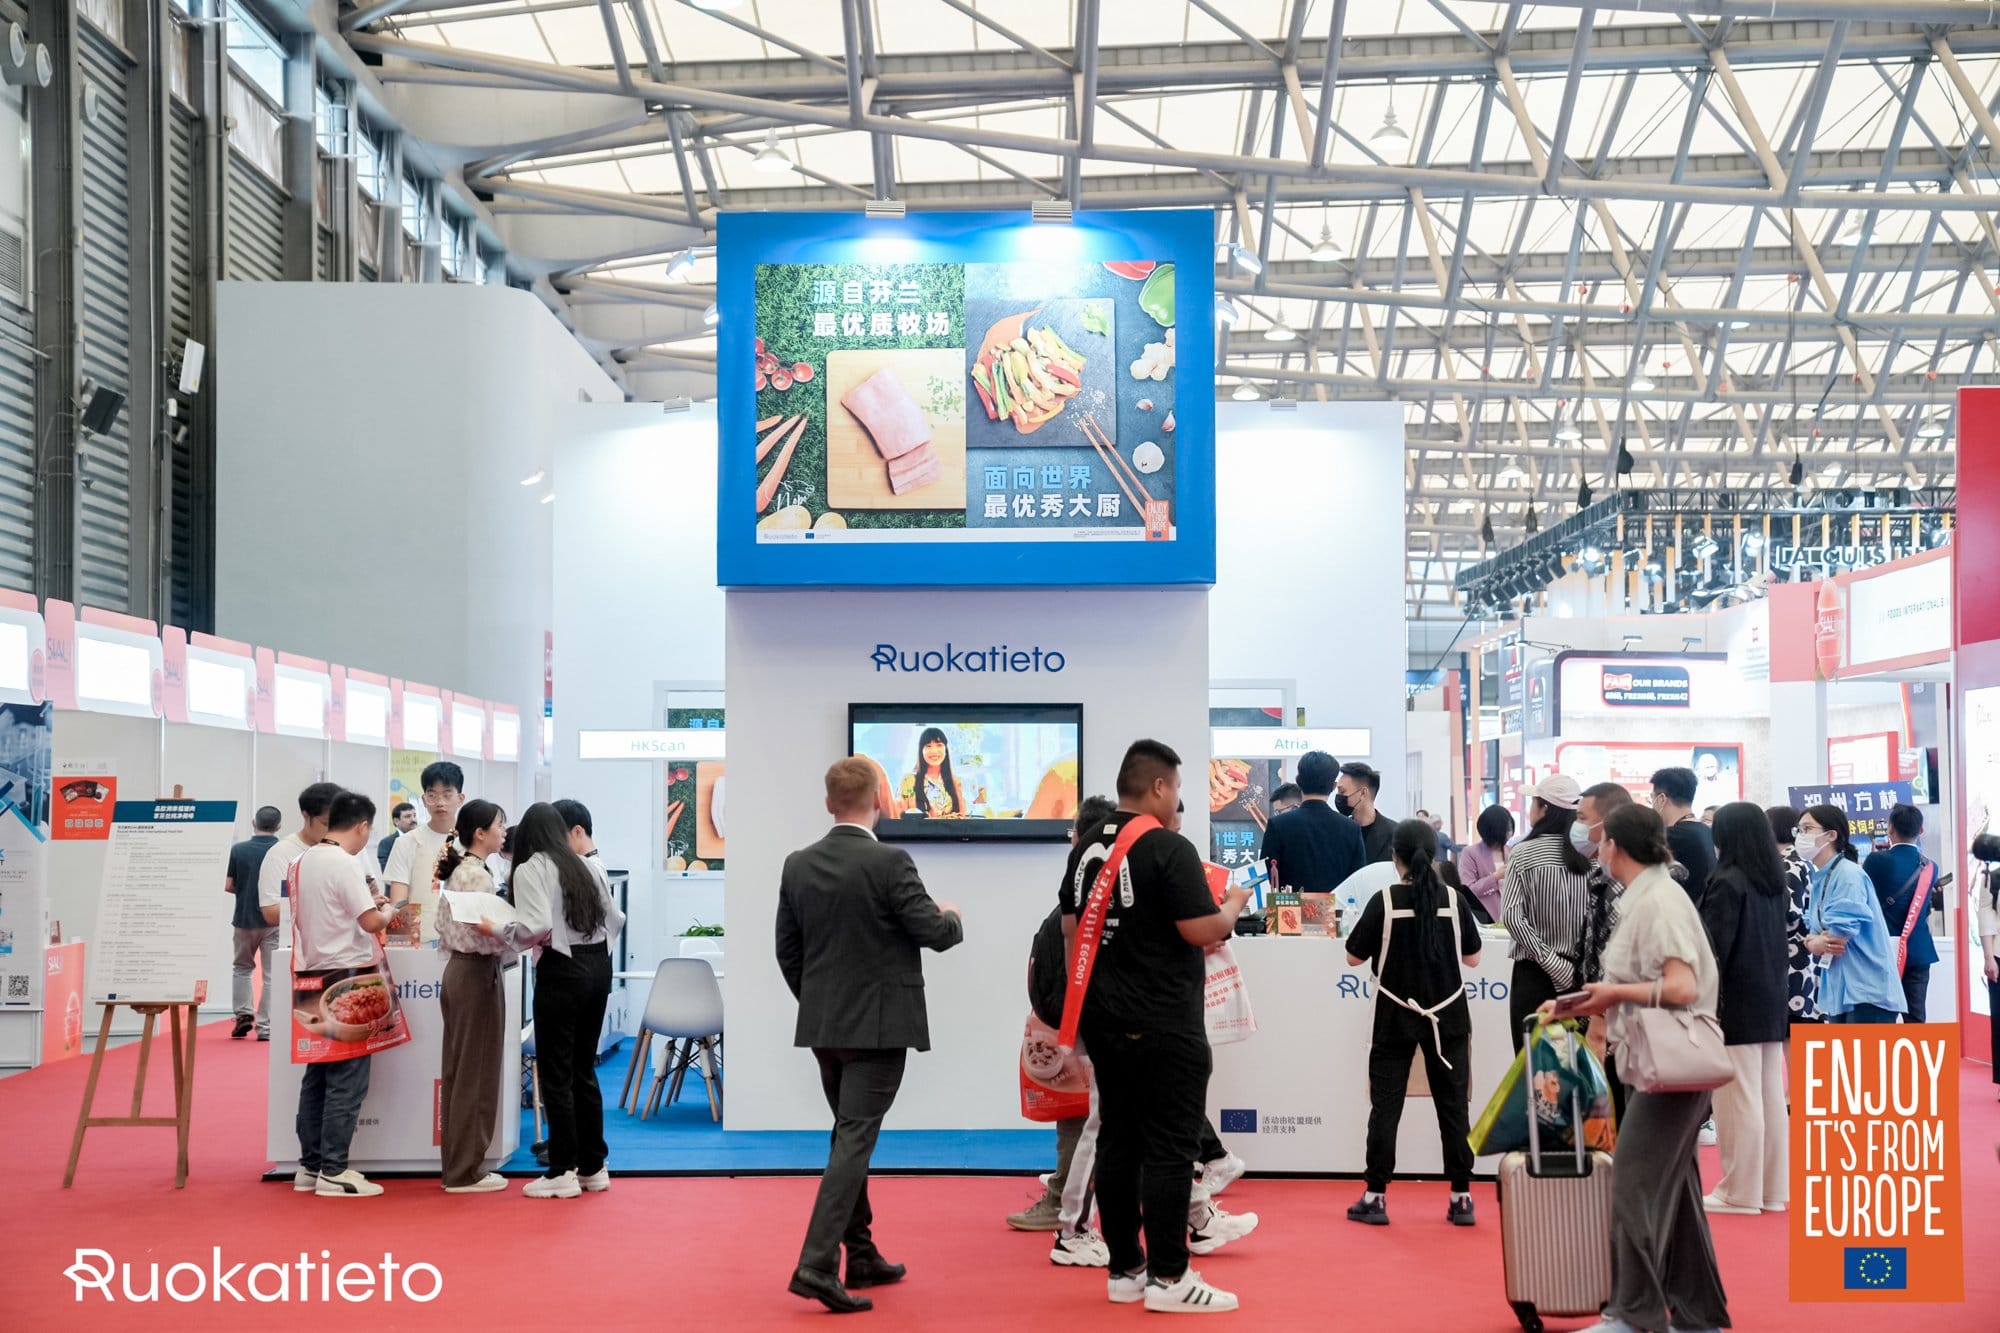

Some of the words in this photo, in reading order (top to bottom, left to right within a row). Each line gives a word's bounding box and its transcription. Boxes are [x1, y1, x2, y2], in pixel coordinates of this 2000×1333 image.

[813, 279, 920, 304] 源自芬兰
[812, 312, 949, 337] 最优质牧场
[984, 466, 1092, 490] 面向世界
[984, 494, 1121, 518] 最优秀大厨
[870, 643, 1065, 672] Ruokatieto
[1653, 679, 1688, 688] BRANDS
[631, 740, 685, 752] HKScan
[1274, 738, 1309, 750] Atria
[1223, 849, 1261, 864] 秀大
[1074, 943, 1090, 986] E6C001
[394, 980, 443, 999] atiet
